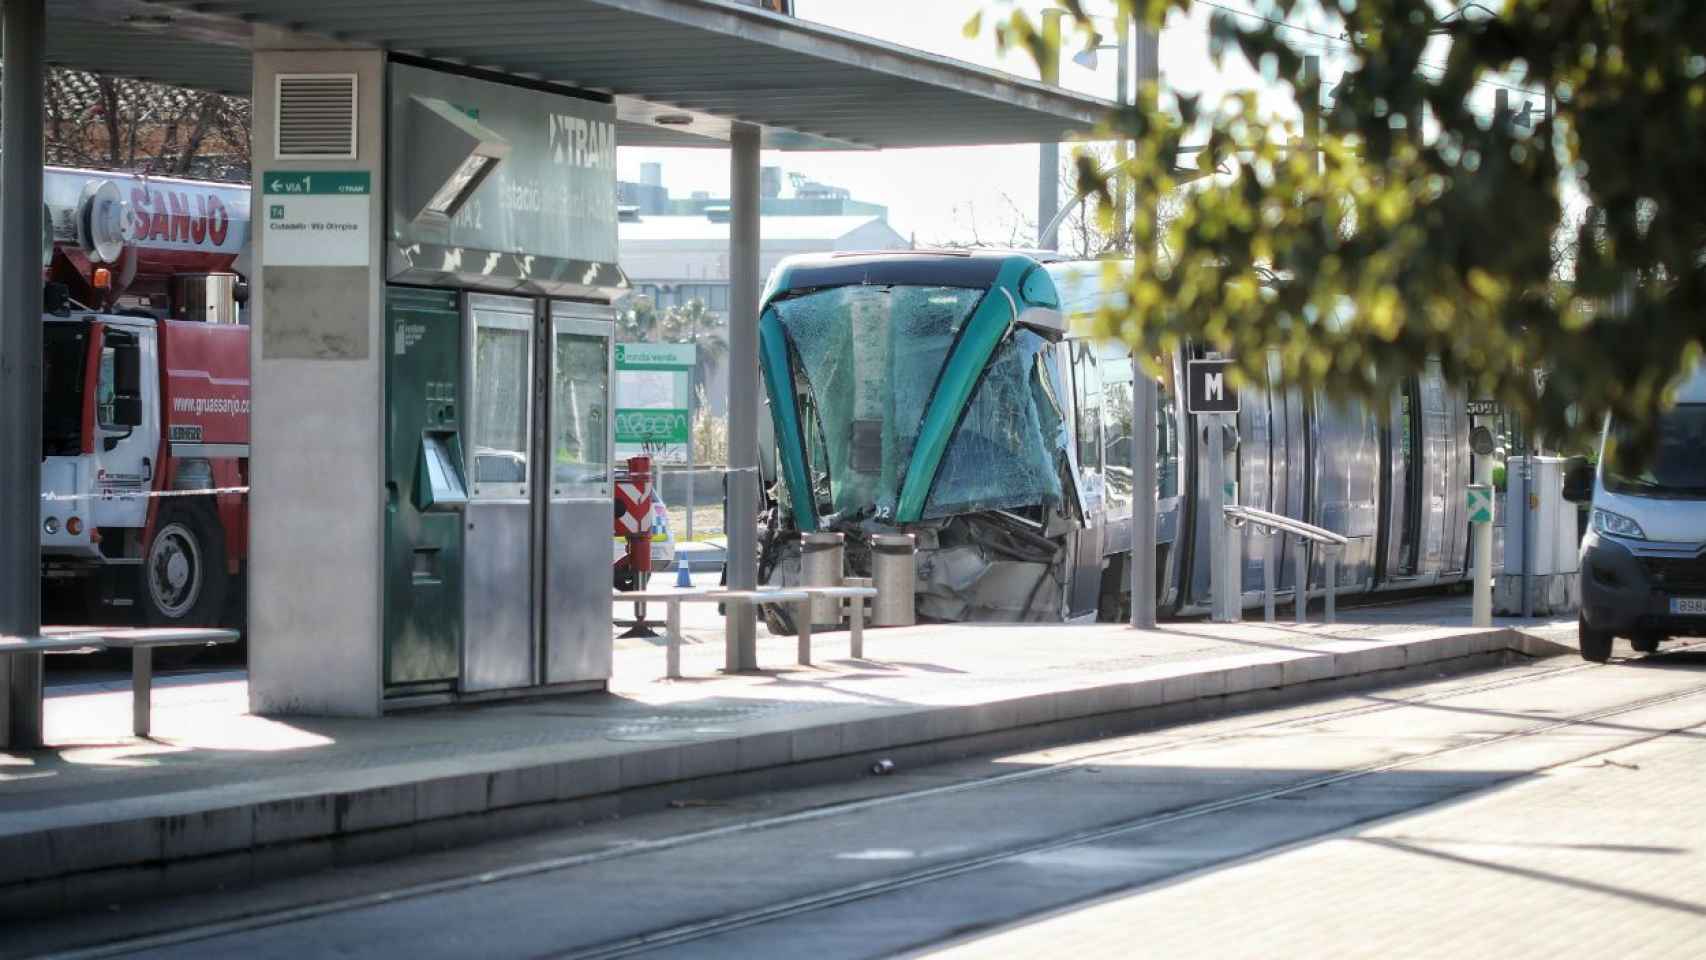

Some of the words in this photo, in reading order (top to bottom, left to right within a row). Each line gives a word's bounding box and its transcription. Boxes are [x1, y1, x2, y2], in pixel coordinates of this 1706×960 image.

[285, 183, 302, 192] VIA
[303, 176, 311, 192] 1
[131, 187, 228, 246] SANJO
[1204, 372, 1224, 401] M
